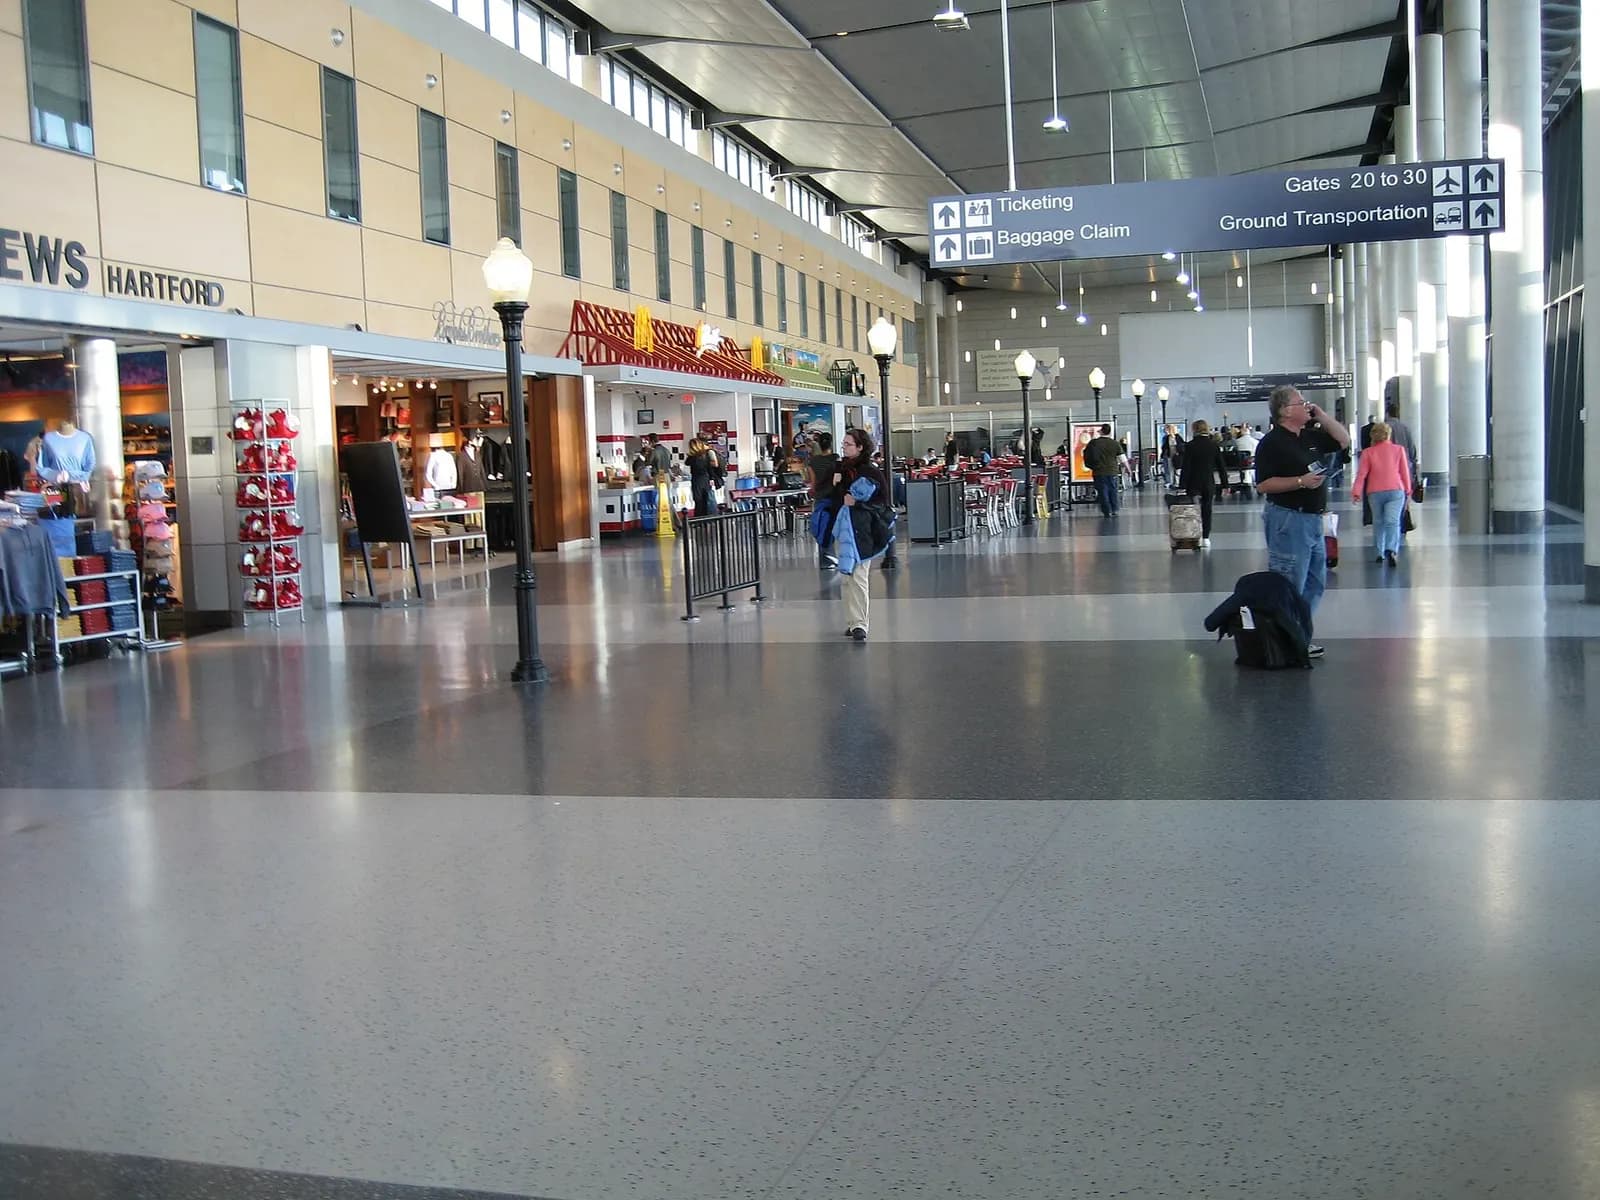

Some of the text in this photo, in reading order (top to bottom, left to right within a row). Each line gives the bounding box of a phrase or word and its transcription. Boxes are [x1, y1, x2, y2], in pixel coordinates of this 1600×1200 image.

[1285, 168, 1427, 193] Gates 20 to 30
[996, 194, 1074, 213] Ticketing
[1219, 205, 1428, 231] Ground Transportation
[997, 223, 1131, 248] Baggage Claim
[0, 227, 90, 290] EWS
[107, 264, 225, 308] HARTFORD
